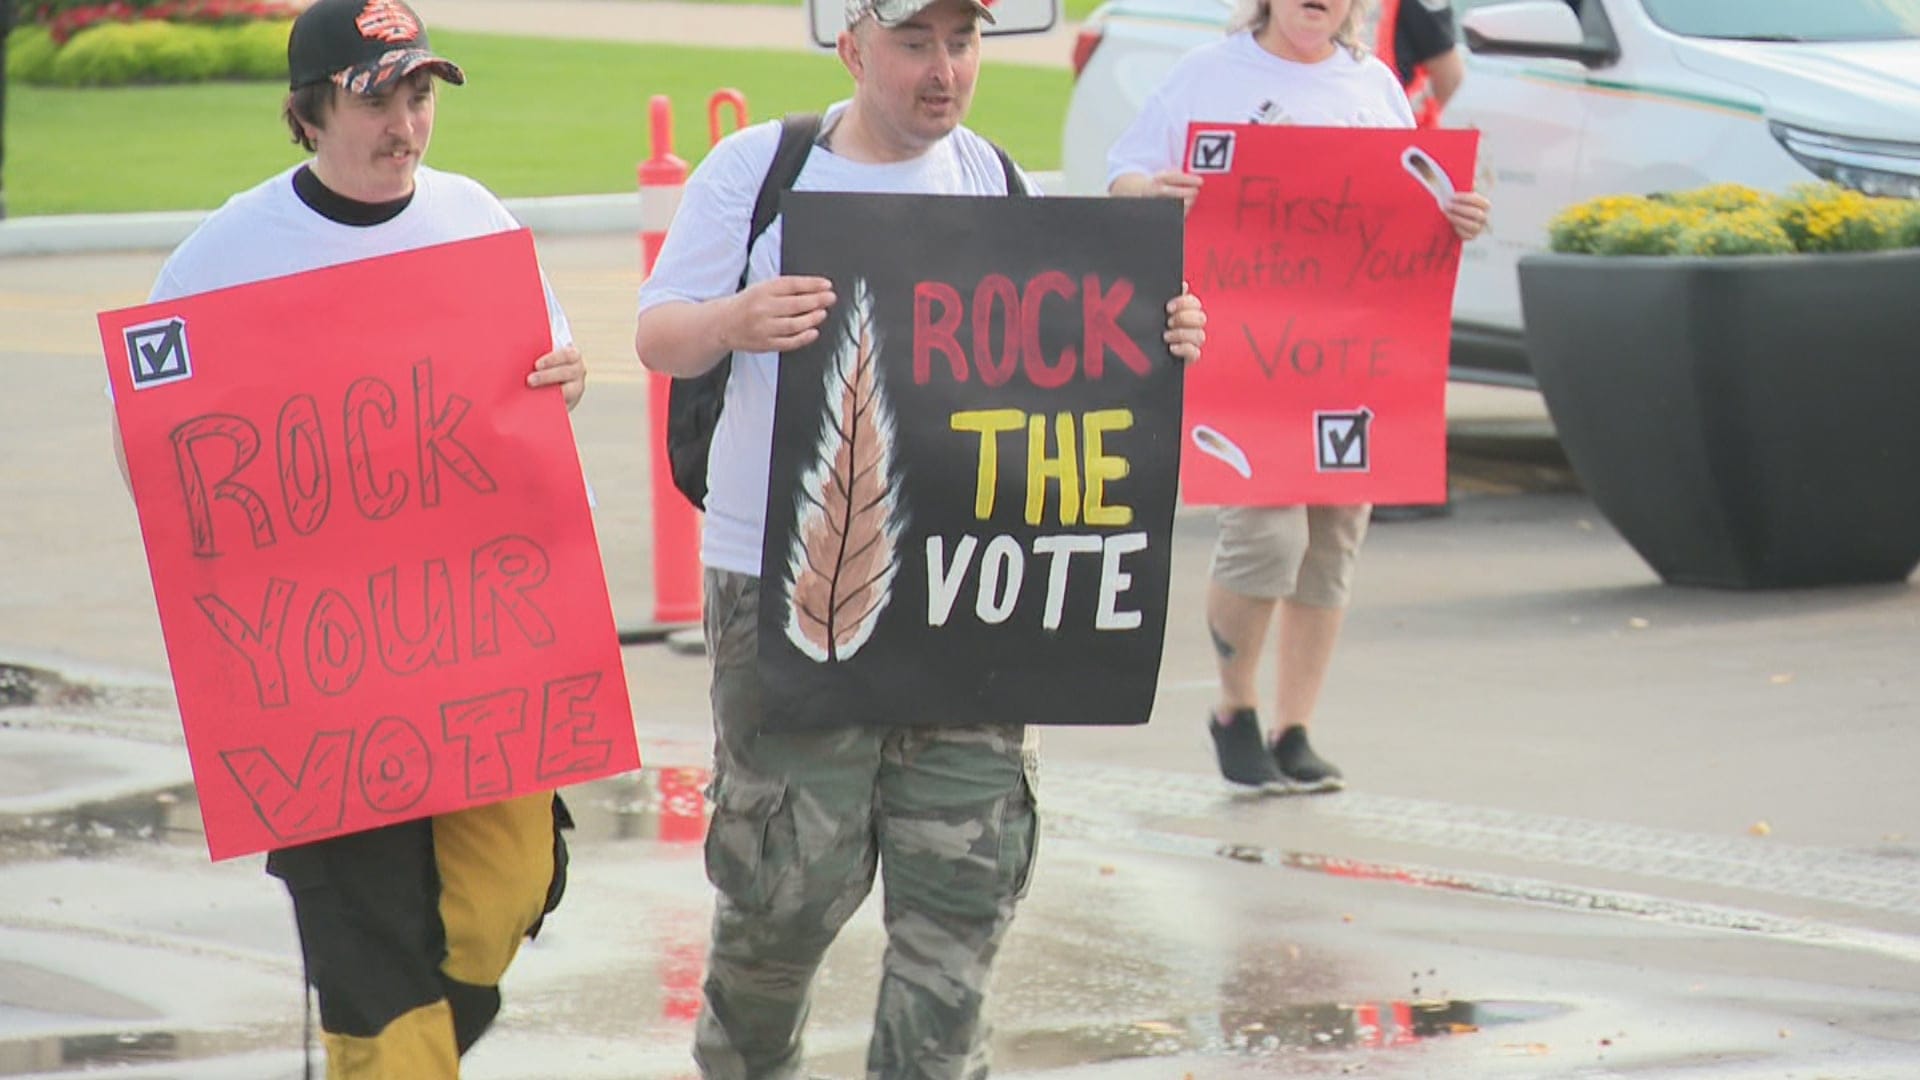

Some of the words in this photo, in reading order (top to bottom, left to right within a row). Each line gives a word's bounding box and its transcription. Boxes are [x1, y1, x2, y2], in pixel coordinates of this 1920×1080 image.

[1235, 174, 1363, 236] First
[1203, 242, 1322, 292] Nation
[913, 270, 1152, 389] ROCK
[1242, 316, 1394, 381] VOTE
[950, 408, 1133, 527] THE
[194, 534, 556, 709] YOUR
[926, 532, 1148, 631] VOTE
[218, 671, 613, 842] VOTE
